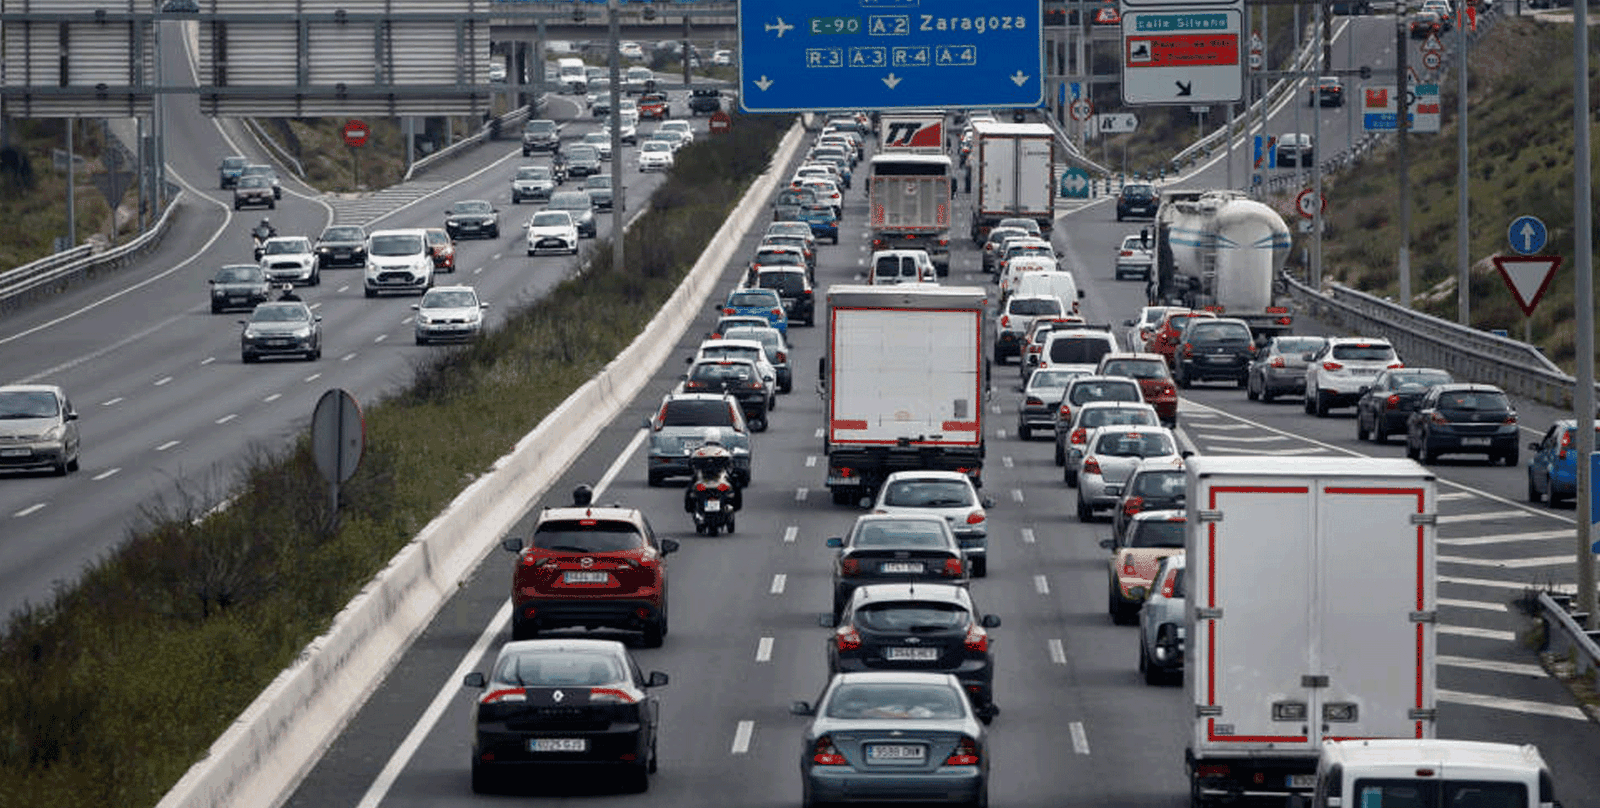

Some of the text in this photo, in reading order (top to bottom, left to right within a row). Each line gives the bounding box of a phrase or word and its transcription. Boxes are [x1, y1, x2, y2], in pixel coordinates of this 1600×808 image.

[811, 14, 1026, 33] E-90 A-2 Zaragoza
[809, 48, 973, 65] R-3 A-3 R-4 A-4
